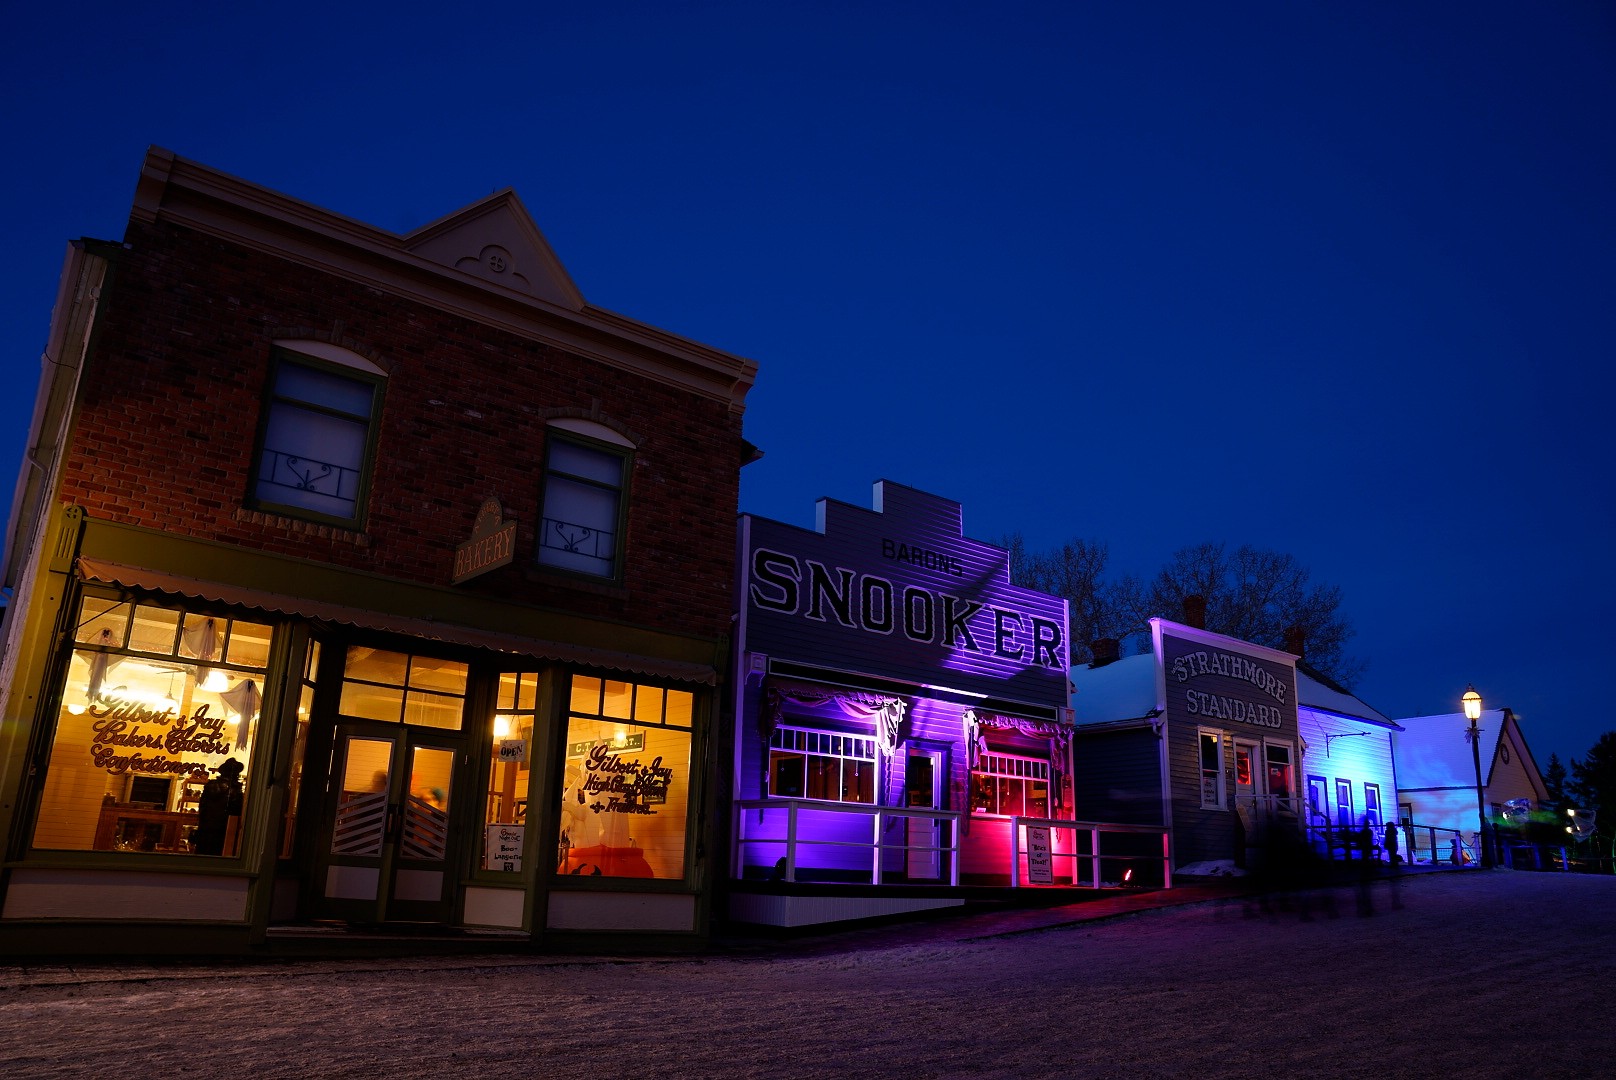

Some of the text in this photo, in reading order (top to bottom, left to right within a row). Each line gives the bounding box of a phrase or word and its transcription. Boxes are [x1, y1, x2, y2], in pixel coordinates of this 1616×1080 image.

[454, 526, 516, 578] BAKERY
[881, 538, 963, 577] BARONS
[749, 547, 1066, 673] SNOOKER
[1173, 651, 1287, 706] STRATHMORE
[89, 686, 176, 726] Gilbert
[1185, 688, 1283, 729] STANDARD
[165, 729, 230, 755] Caterers
[501, 744, 523, 757] OPEN
[583, 773, 611, 795] High
